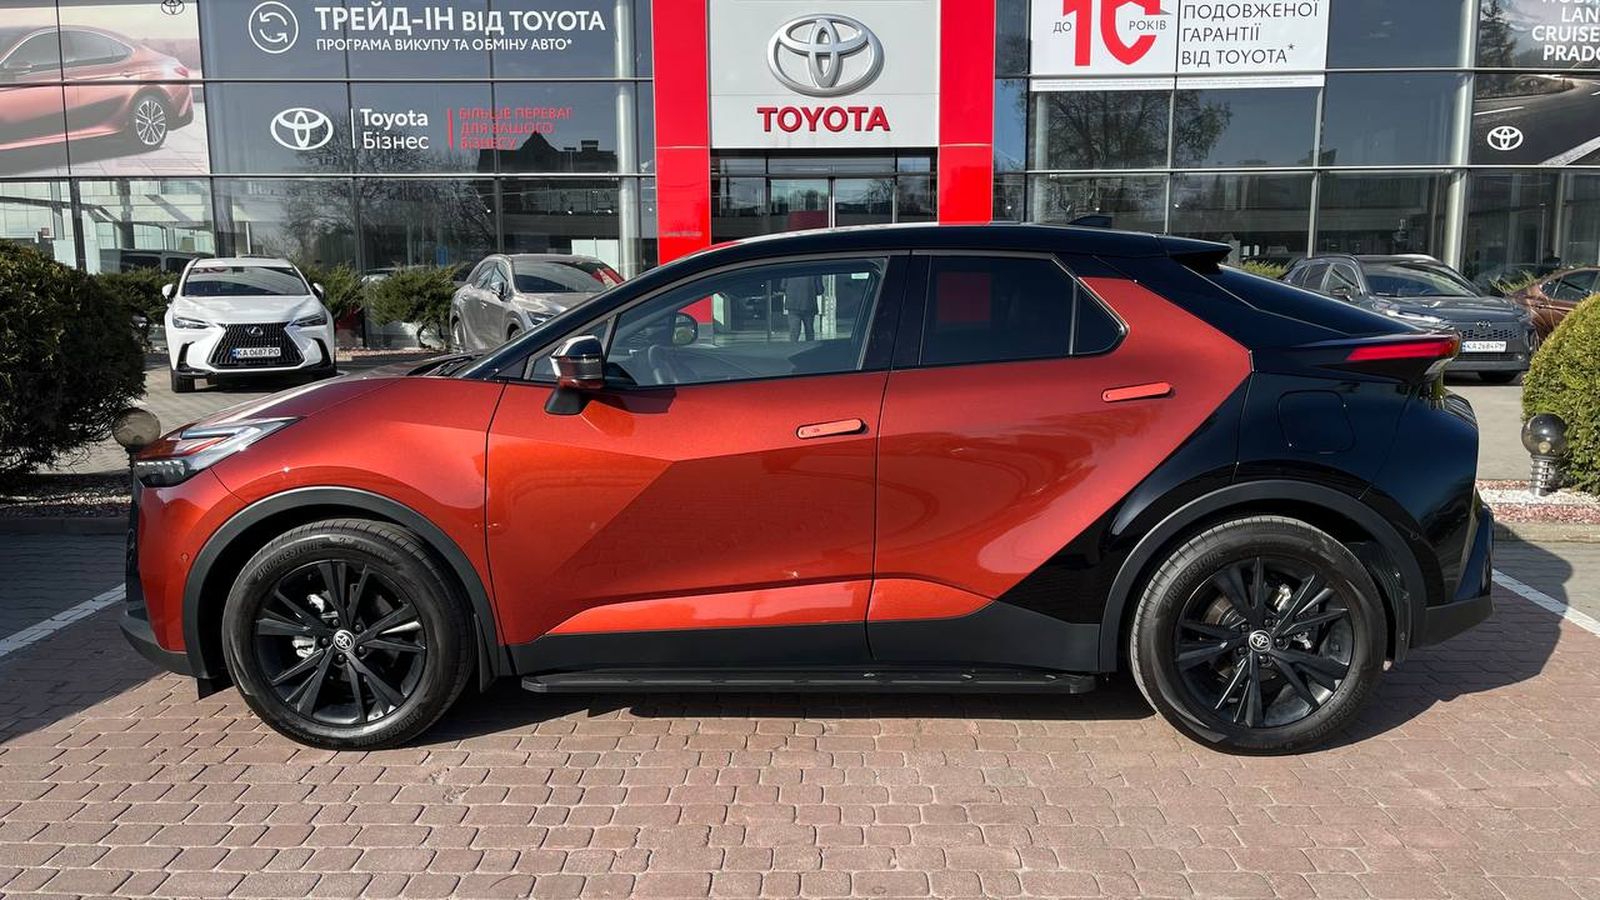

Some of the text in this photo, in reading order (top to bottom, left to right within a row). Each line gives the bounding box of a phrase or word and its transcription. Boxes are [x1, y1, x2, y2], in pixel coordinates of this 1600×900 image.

[315, 2, 606, 36] ТРЕЙД-ІН ВІД TOYOTA
[1183, 0, 1319, 21] ПОДОВЖЕНОЇ
[1053, 21, 1072, 34] ДО
[1128, 20, 1167, 31] РОКІВ
[1182, 22, 1260, 43] ГАРАНТІЇ
[316, 38, 392, 51] ПРОГРАМА
[395, 38, 449, 51] ВИКУПУ
[453, 38, 469, 51] ТА
[472, 38, 528, 51] ОБМІНУ
[1543, 45, 1600, 61] PRAD
[1181, 49, 1210, 68] ВІД
[360, 108, 429, 131] Toyota
[514, 107, 572, 121] ПЕРЕВАГ
[757, 106, 891, 133] TOYOTA
[362, 131, 429, 150] Бізнес
